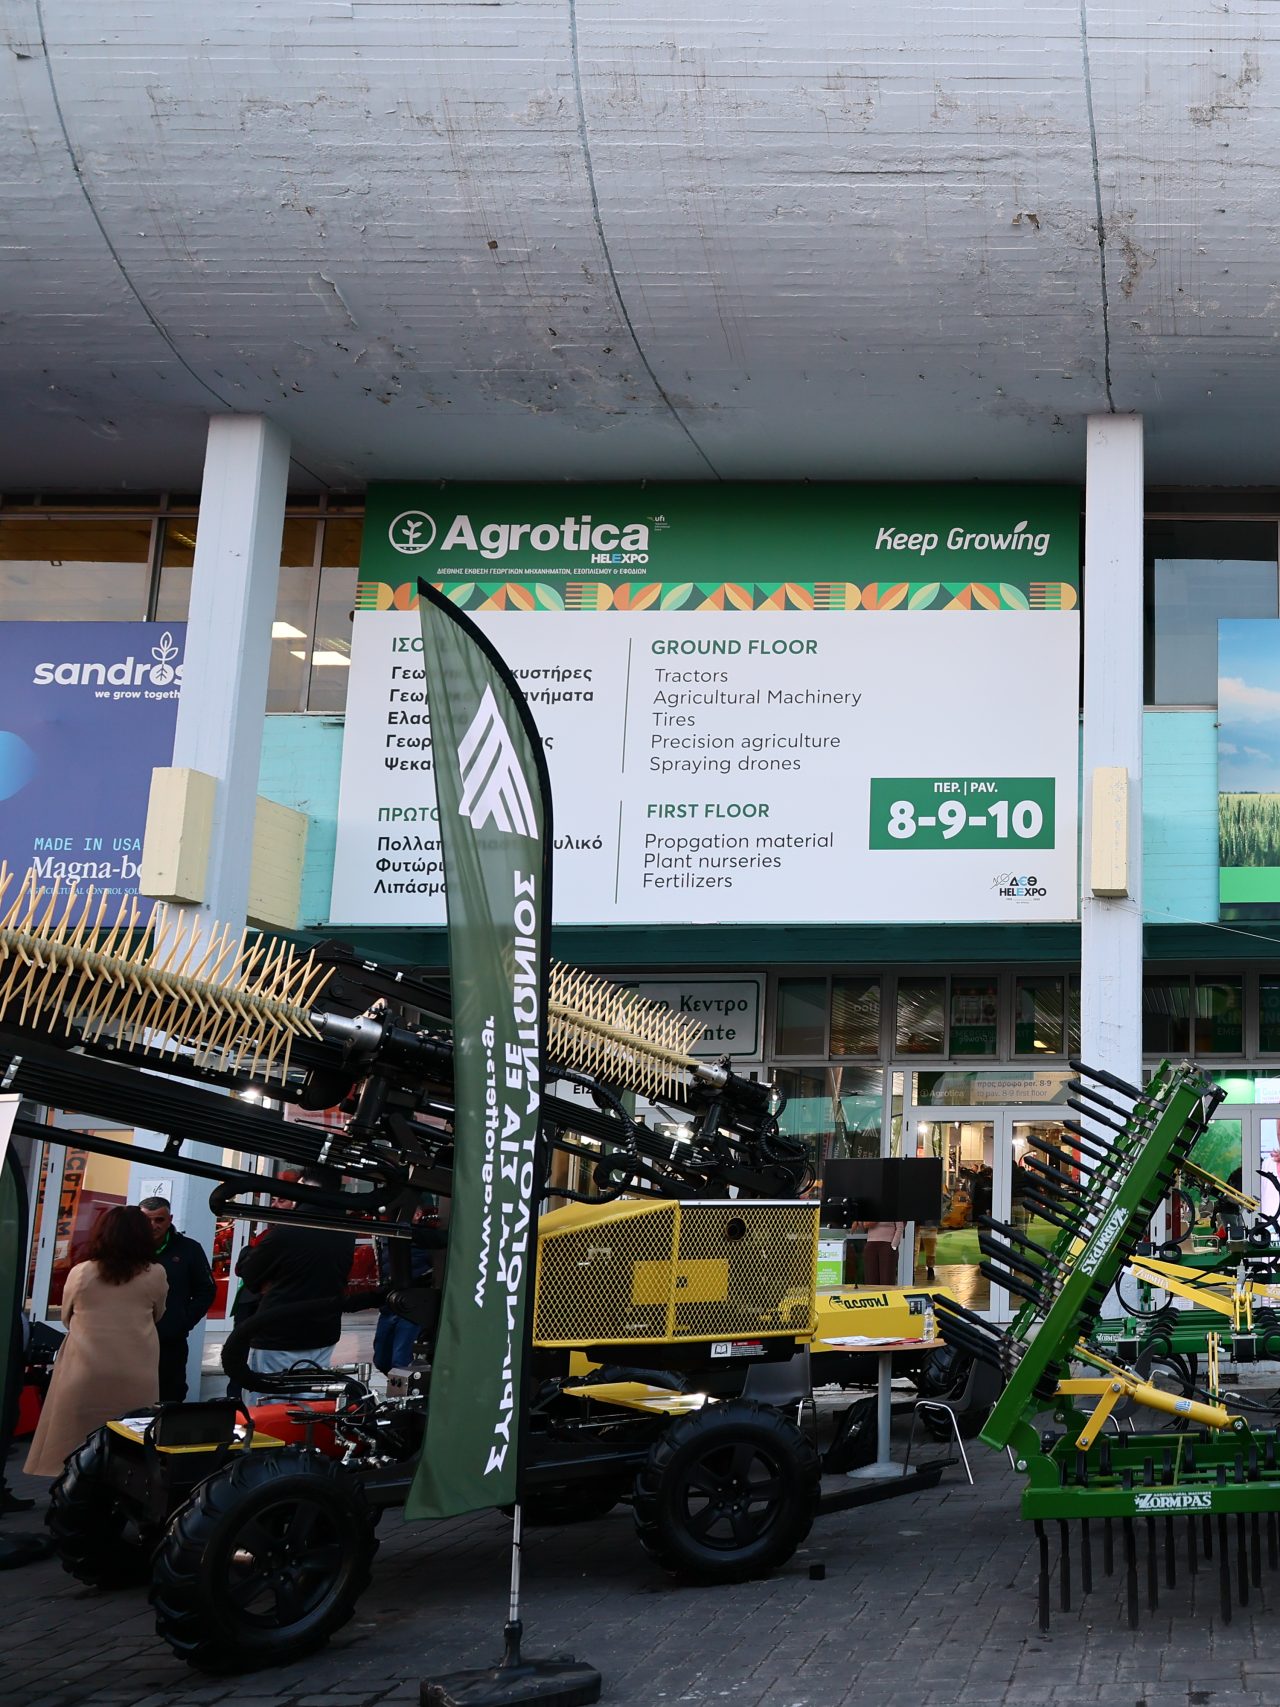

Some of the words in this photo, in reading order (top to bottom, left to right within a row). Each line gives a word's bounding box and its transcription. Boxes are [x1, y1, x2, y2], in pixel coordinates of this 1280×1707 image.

[440, 515, 649, 559] Agrotica
[875, 527, 938, 556] Keep
[946, 521, 1050, 556] Growing
[591, 553, 649, 564] HELEXPO
[651, 640, 741, 655] GROUND
[748, 640, 818, 654] FLOOR
[655, 668, 728, 683] Tractors
[95, 690, 110, 698] we
[113, 690, 141, 700] grow
[653, 689, 760, 707] Agricultural
[767, 689, 862, 707] Machinery
[652, 712, 696, 726] Tires
[651, 734, 734, 749] Precision
[741, 733, 841, 751] agriculture
[650, 756, 731, 774] Spraying
[738, 756, 801, 771] drones
[934, 782, 961, 793] ΠΕΡ.
[970, 782, 998, 793] PAV.
[647, 804, 699, 818] FIRST
[705, 803, 770, 818] FLOOR
[887, 800, 1043, 840] 8-9-10
[34, 838, 73, 851] MADE
[84, 838, 102, 851] IN
[113, 838, 141, 851] USA
[554, 835, 603, 850] υλικό
[645, 834, 749, 852] Propgation
[756, 832, 833, 848] material
[644, 853, 693, 868] Plant
[699, 853, 782, 868] nurseries
[643, 873, 733, 888] Fertilizers
[87, 887, 122, 895] CONROL
[1000, 887, 1047, 897] HELEXPO
[680, 995, 748, 1015] Κεντρο
[1081, 1207, 1128, 1276] ZORMPAS
[1139, 1493, 1212, 1509] ZORMPAS
